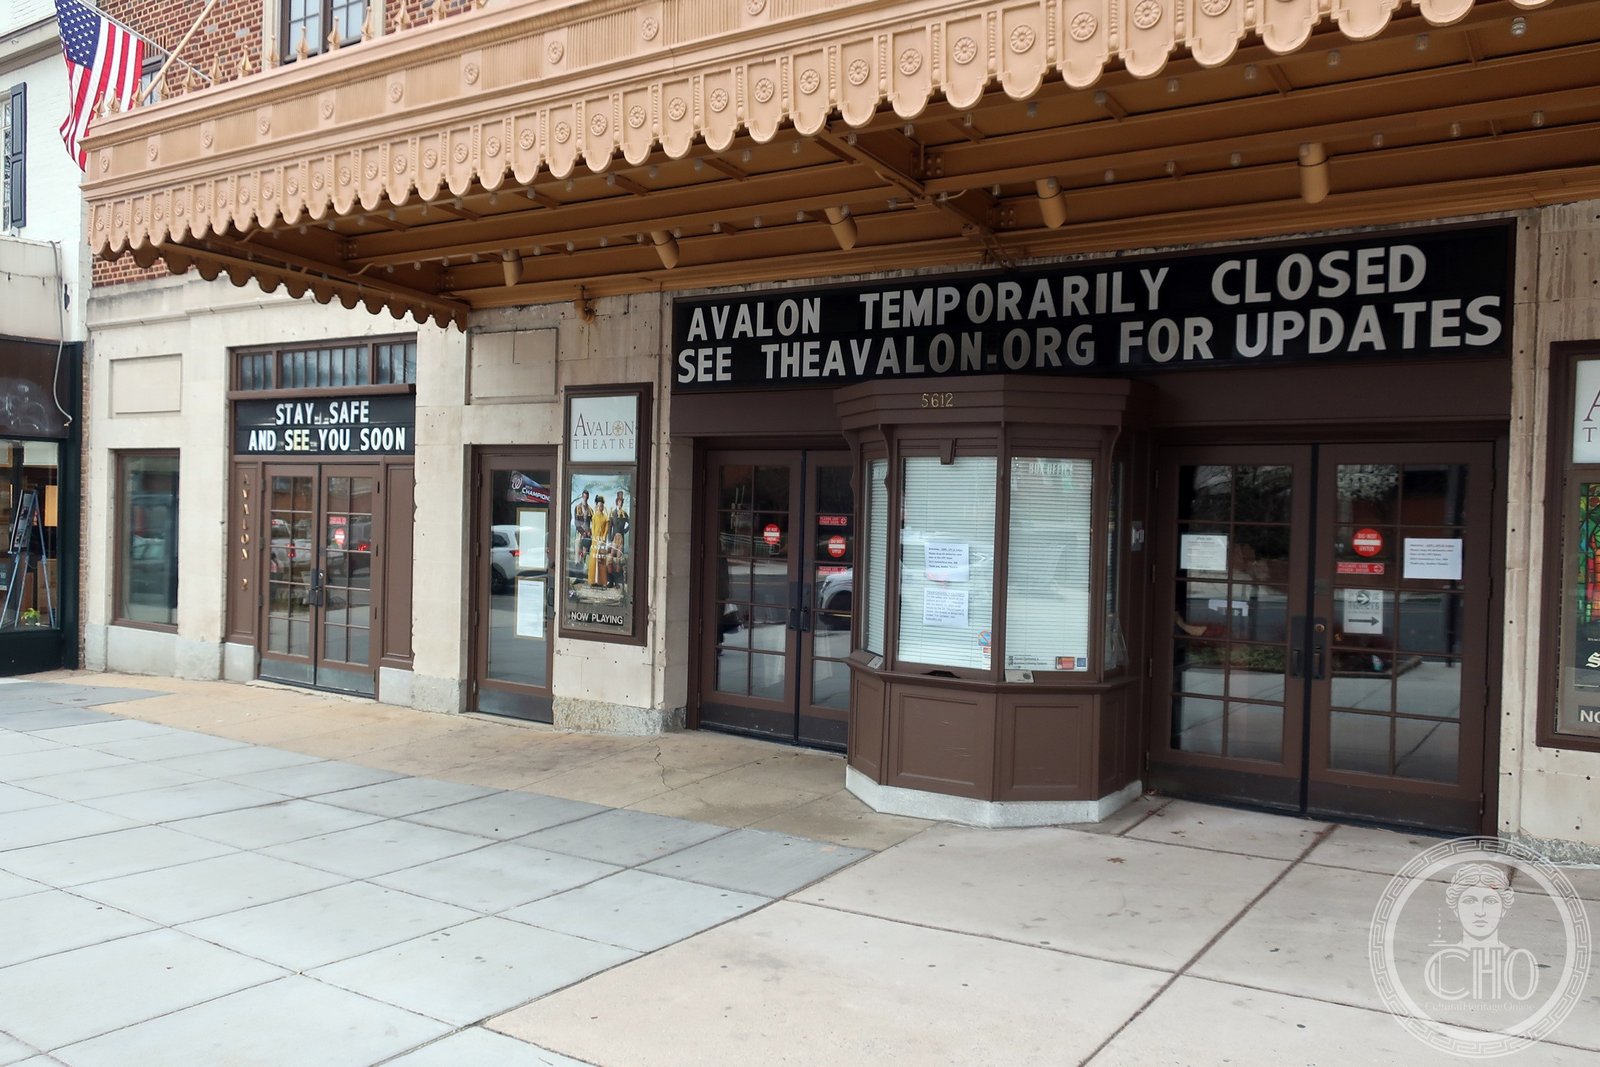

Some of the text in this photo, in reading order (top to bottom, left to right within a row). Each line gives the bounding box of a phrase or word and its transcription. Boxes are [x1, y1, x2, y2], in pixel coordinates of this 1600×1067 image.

[687, 244, 1427, 342] AVALON TEMPORARILY CLOSED
[677, 346, 732, 384] SEE
[1119, 317, 1215, 364] FOR
[1235, 296, 1502, 357] UPDATES
[921, 392, 954, 408] 5612
[275, 401, 369, 425] STAY SAFE
[248, 427, 406, 451] AND SEE YOU SOON
[573, 438, 634, 450] THEATRE
[571, 611, 624, 625] NOW PLAYING
